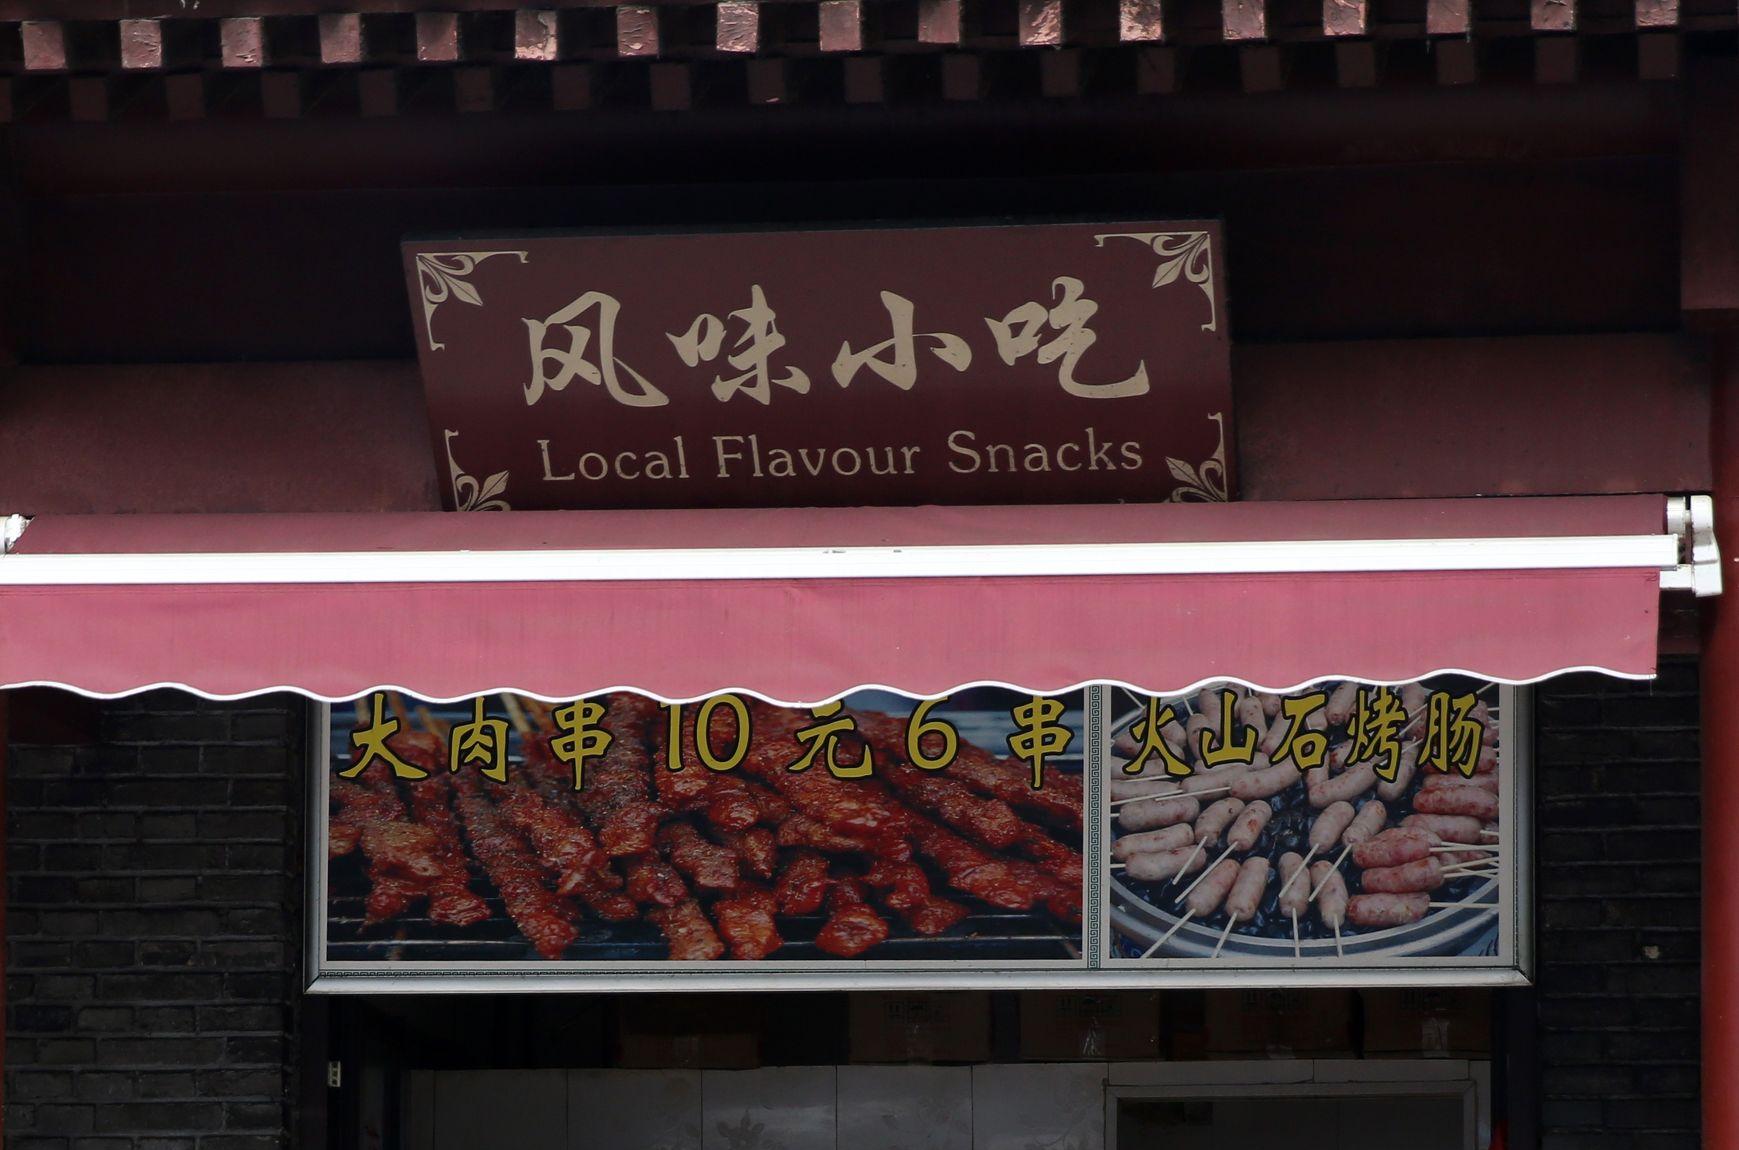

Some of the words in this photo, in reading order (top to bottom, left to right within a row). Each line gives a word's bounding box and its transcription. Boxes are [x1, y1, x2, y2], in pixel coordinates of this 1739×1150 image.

[522, 276, 1150, 408] 风味小吃
[537, 435, 690, 482] Local
[712, 431, 921, 479] Flavour
[947, 426, 1143, 474] Snacks
[1124, 687, 1484, 783] 火山石烤肠
